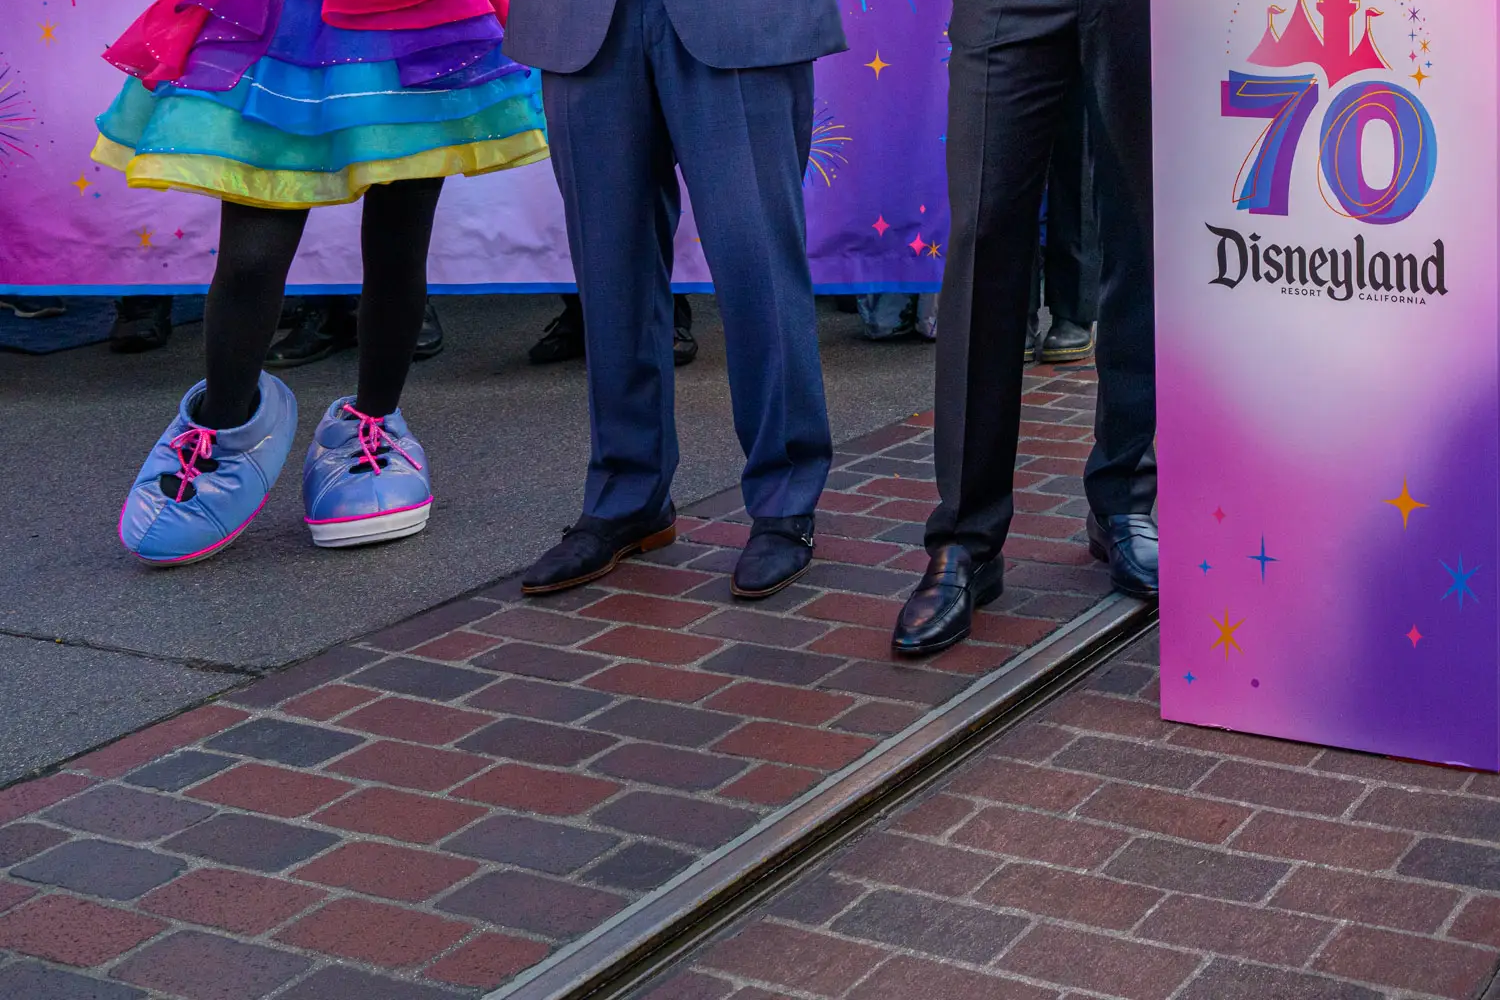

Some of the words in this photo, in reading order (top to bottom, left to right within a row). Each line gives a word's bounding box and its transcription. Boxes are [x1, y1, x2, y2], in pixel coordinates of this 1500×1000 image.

[1221, 70, 1438, 225] 70
[1204, 221, 1449, 302] Disneyland
[1281, 287, 1322, 297] RESORT
[1358, 292, 1427, 306] CALIFORNIA
